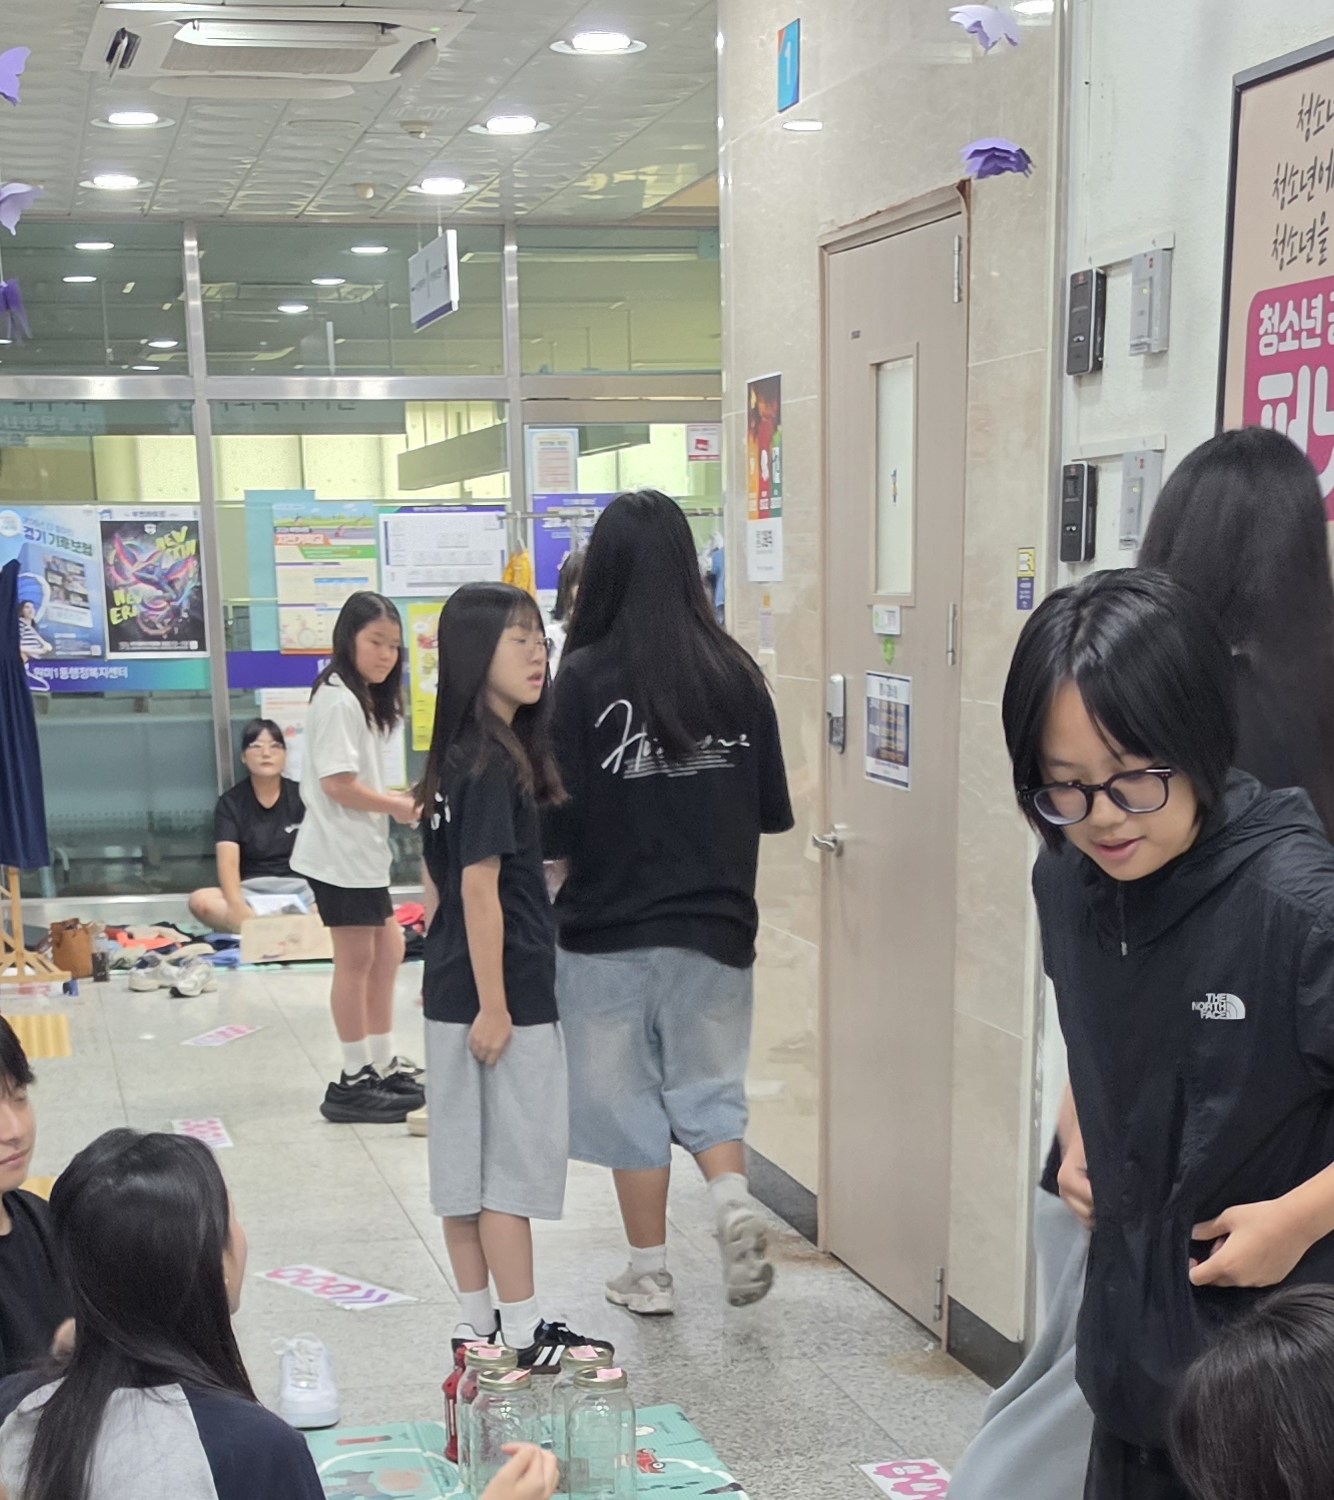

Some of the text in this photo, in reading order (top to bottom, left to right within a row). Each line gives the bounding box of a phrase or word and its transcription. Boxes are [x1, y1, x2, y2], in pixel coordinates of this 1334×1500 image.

[1271, 210, 1329, 271] 청소년을
[1259, 293, 1323, 356] 청소년
[1206, 993, 1227, 1003] THE
[1191, 1001, 1226, 1011] NORTH
[1200, 1010, 1227, 1019] FACE
